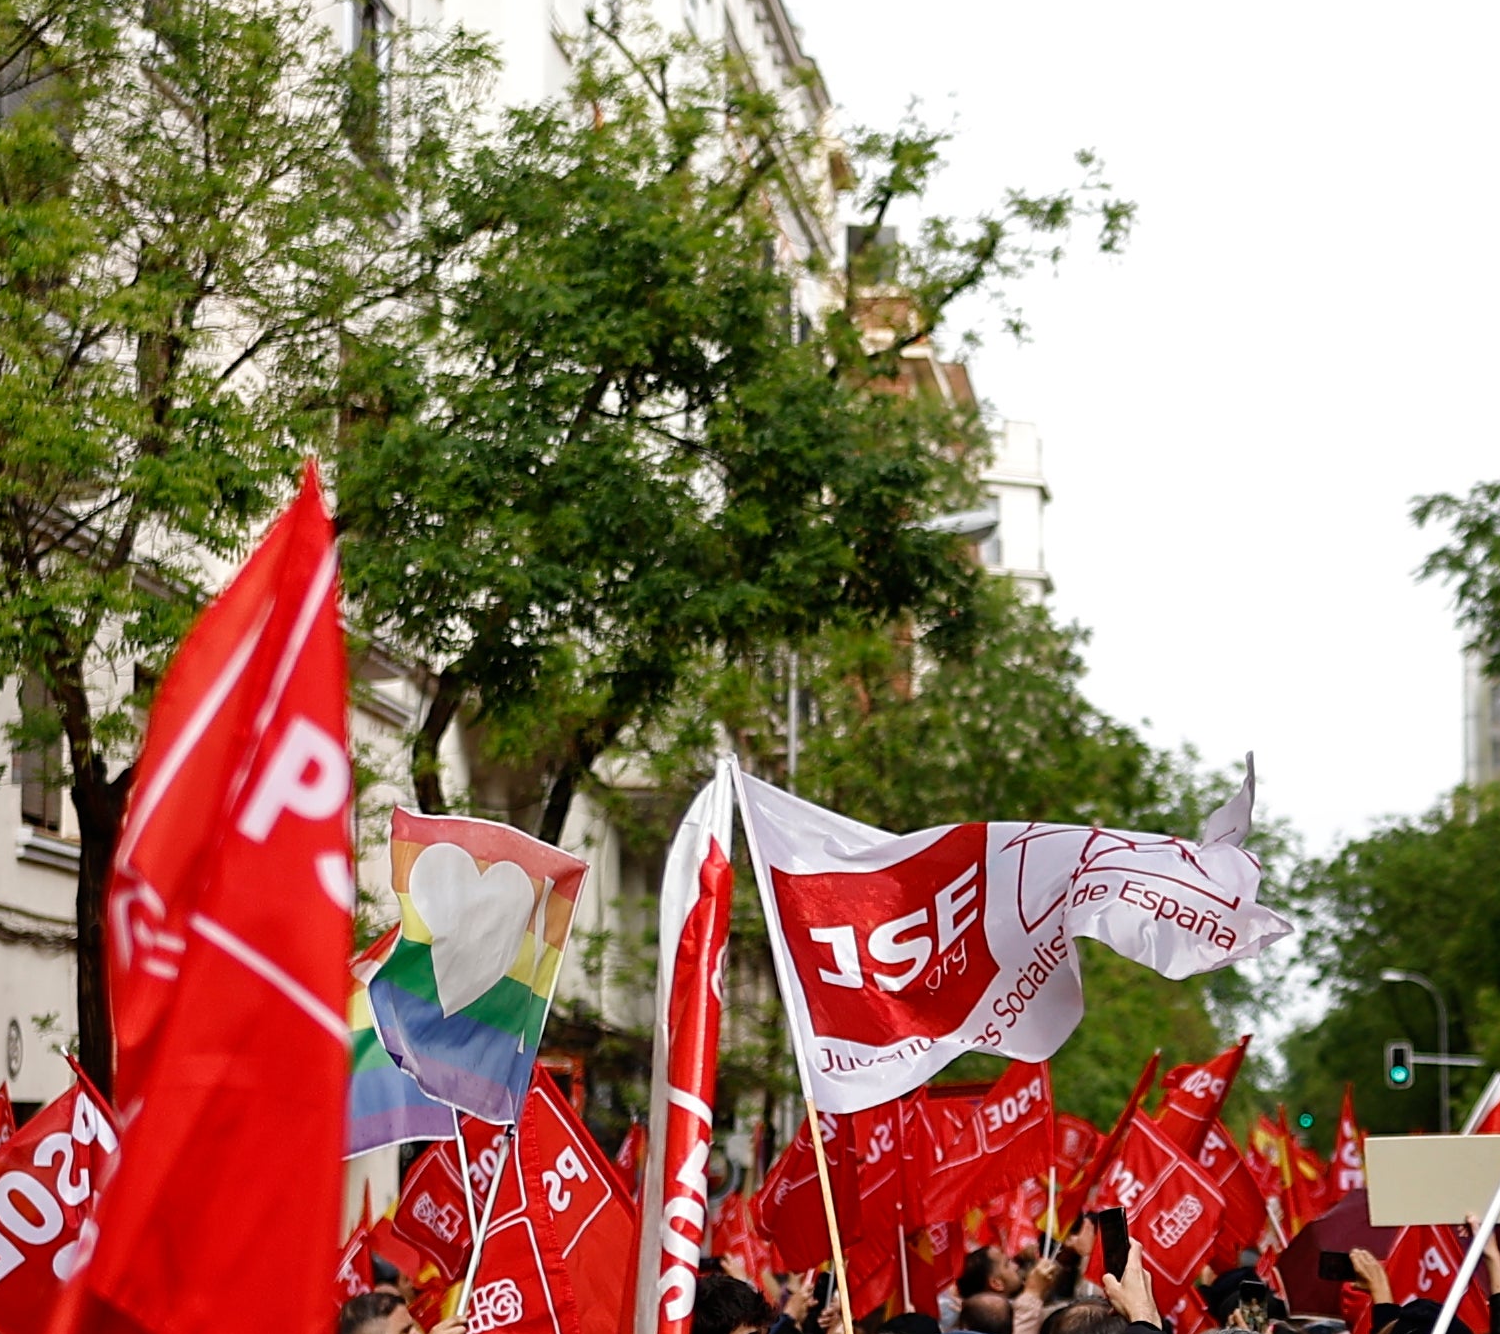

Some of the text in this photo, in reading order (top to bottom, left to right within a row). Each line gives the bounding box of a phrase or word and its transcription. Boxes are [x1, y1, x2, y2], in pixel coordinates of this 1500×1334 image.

[809, 862, 978, 993] JSE
[992, 924, 1068, 1029] Socialis
[1072, 883, 1109, 908] de
[1118, 880, 1238, 952] España
